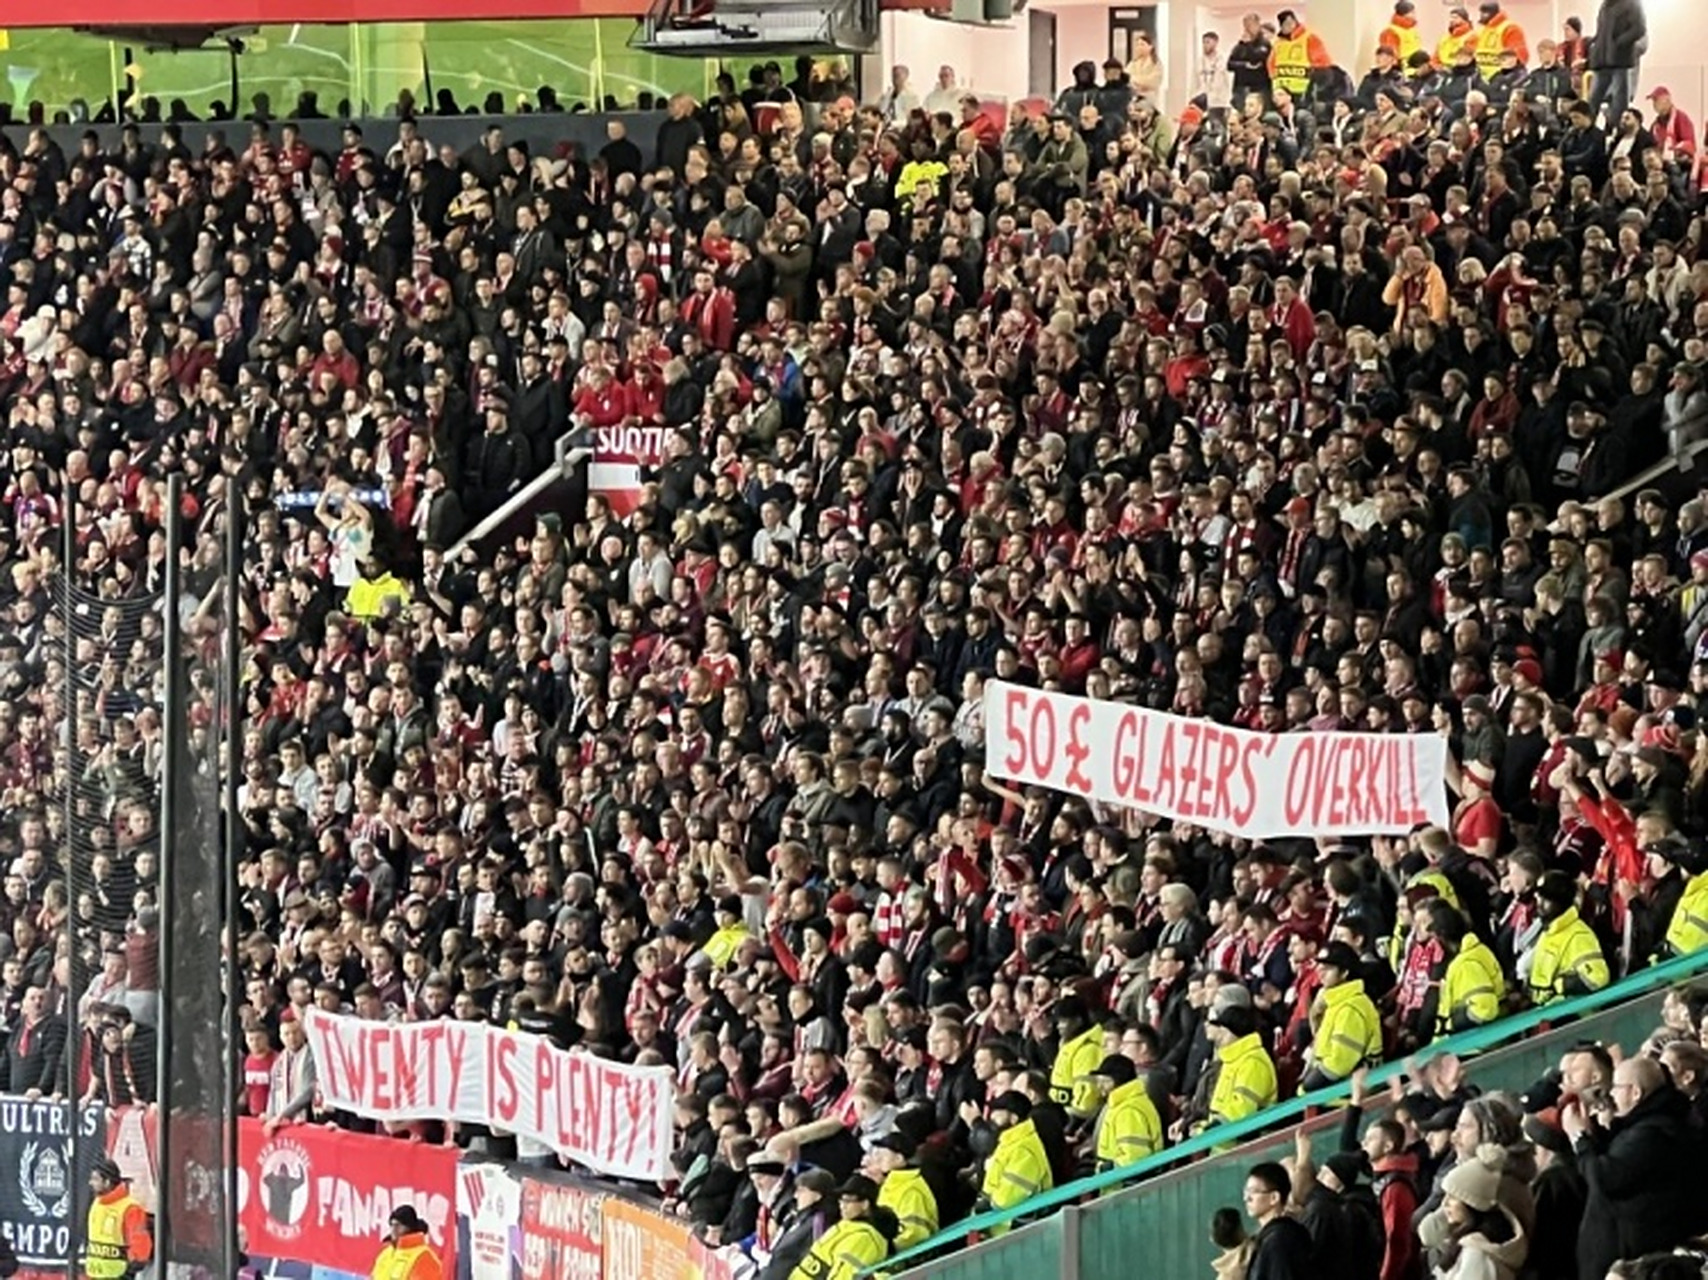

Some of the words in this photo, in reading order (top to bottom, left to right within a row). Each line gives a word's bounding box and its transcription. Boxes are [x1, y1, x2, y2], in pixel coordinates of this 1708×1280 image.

[1112, 711, 1279, 827] GLAZERS'
[1284, 736, 1427, 826] OVERKILL
[314, 1017, 466, 1113] TWENTY
[487, 1033, 519, 1122] IS
[536, 1044, 657, 1173] PLENTY!
